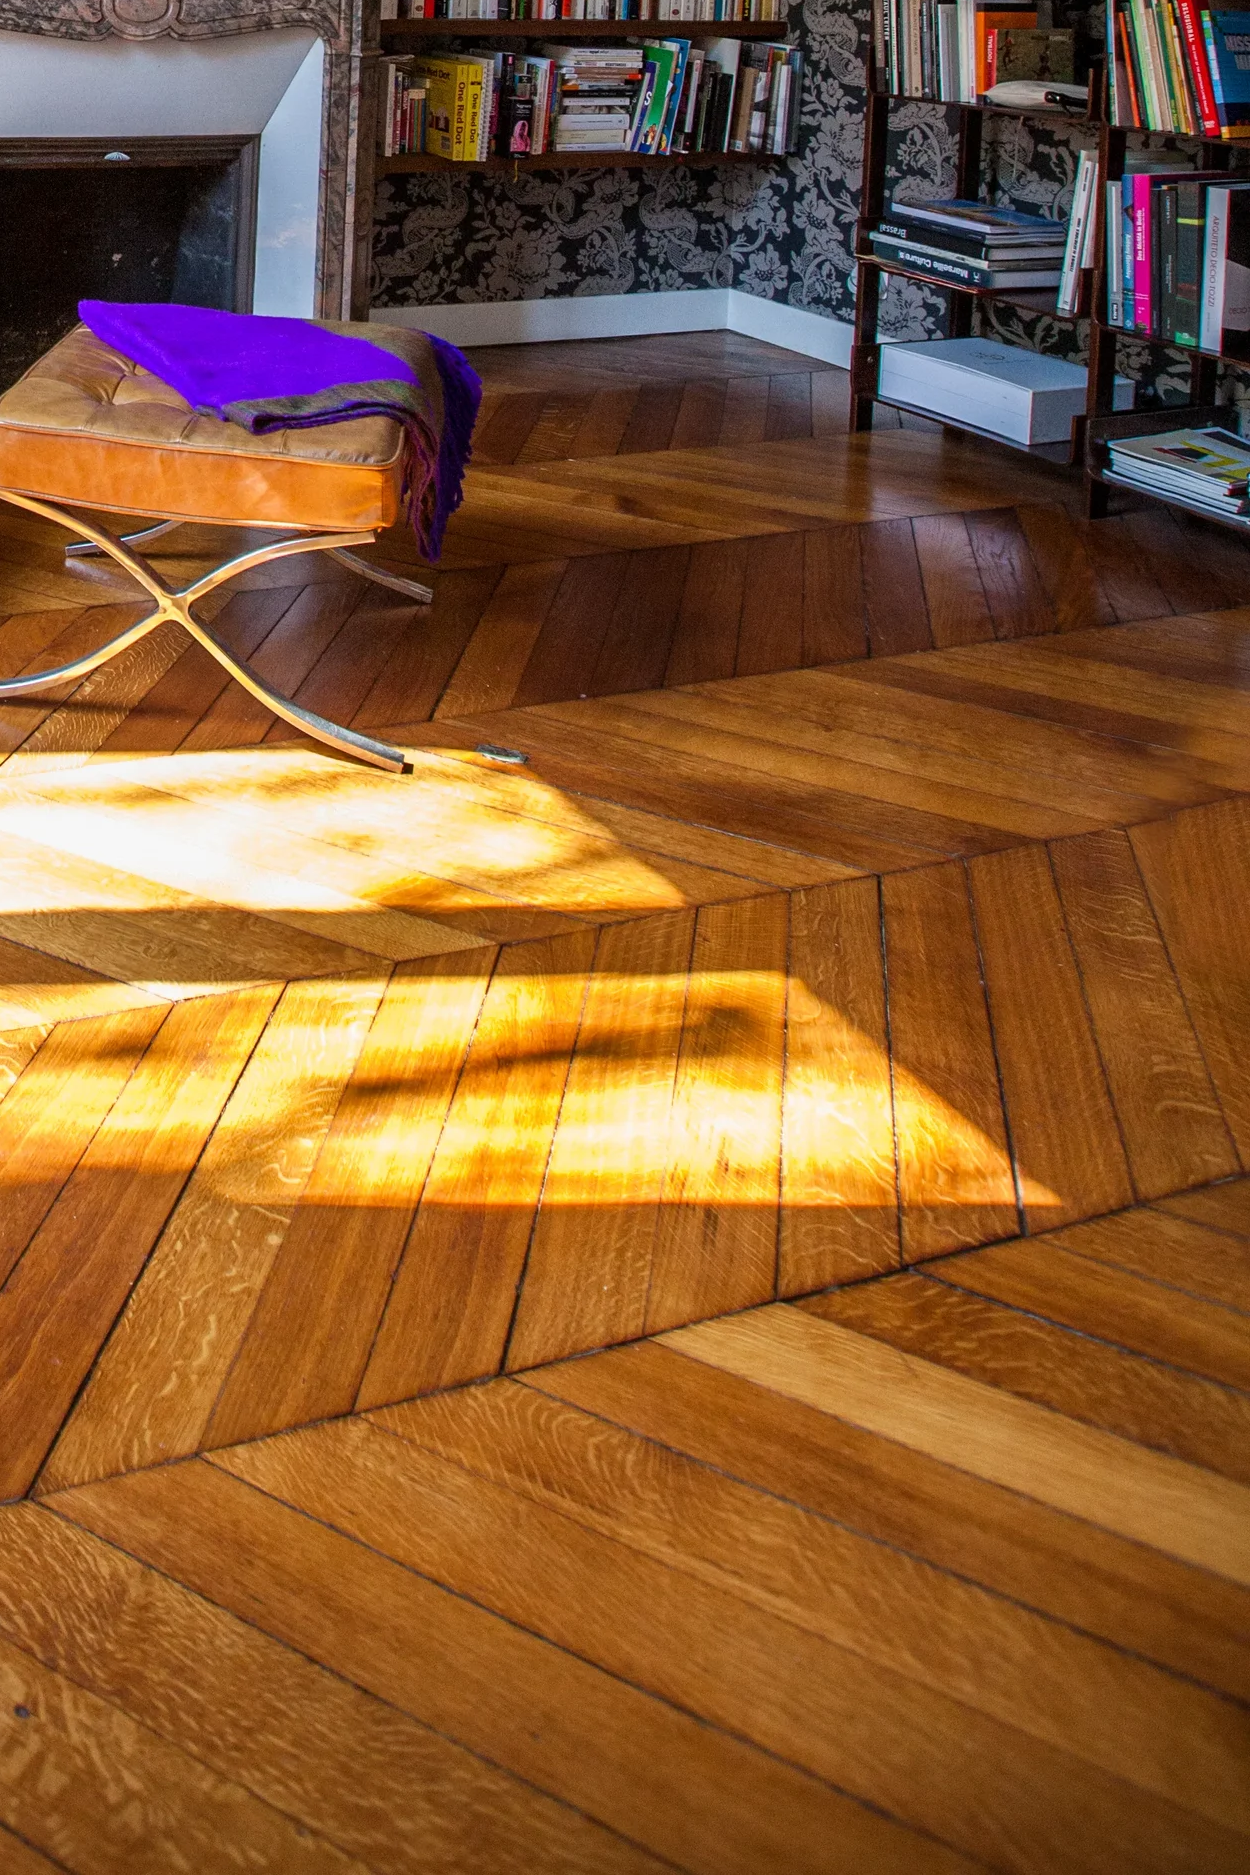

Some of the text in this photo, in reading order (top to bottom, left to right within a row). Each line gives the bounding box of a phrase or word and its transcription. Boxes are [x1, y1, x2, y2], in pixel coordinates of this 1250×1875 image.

[1181, 2, 1195, 43] DELUSIONAL
[426, 66, 437, 76] Red
[438, 68, 451, 80] Dot
[455, 81, 466, 145] One Red Dot
[469, 128, 477, 144] Dot
[933, 261, 969, 279] Marseille
[1124, 255, 1132, 279] Gormley
[1207, 216, 1219, 307] ARQUITETO DECIO TOZZI
